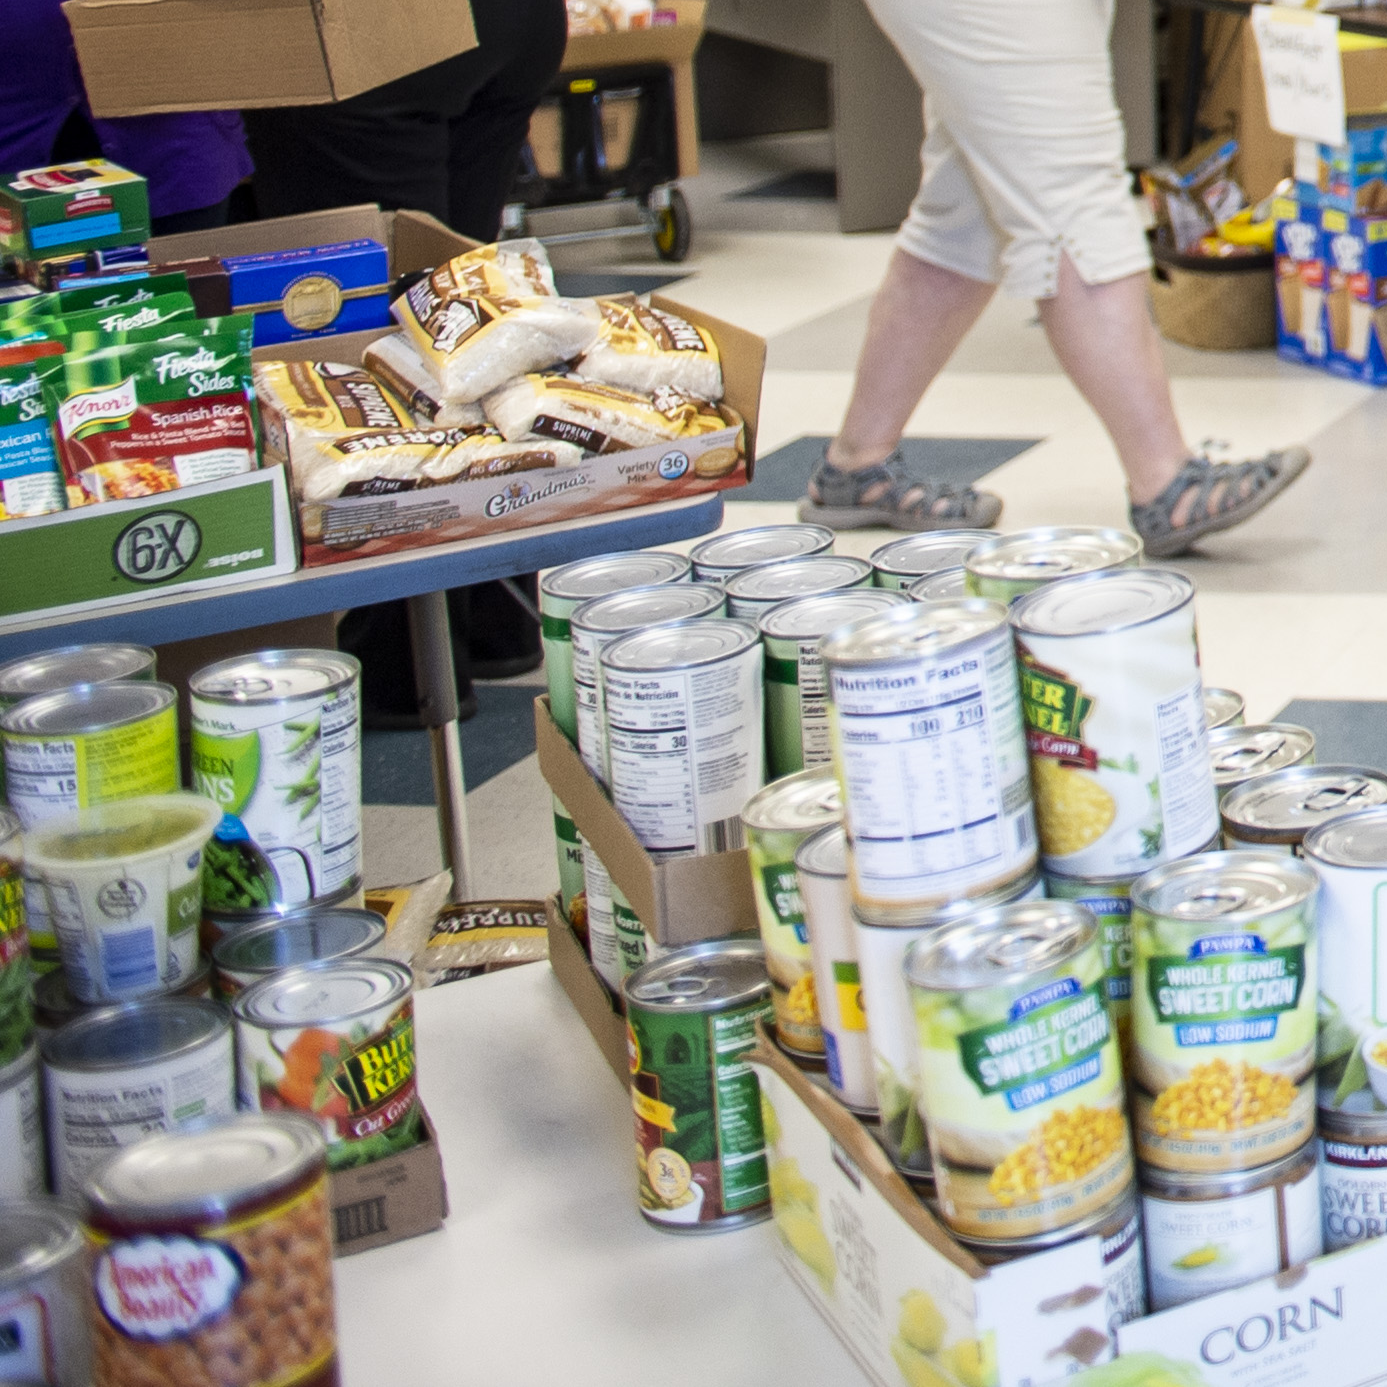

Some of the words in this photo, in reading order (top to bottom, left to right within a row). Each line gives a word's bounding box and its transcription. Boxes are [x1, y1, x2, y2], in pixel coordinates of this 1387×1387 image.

[97, 306, 162, 333] Fiesta
[153, 346, 217, 385] Fiesta
[188, 373, 236, 397] Sides
[64, 394, 132, 426] Knorr
[151, 408, 211, 429] Spanish
[211, 404, 243, 417] Rice
[552, 420, 593, 442] SUPREME
[617, 460, 658, 475] Variety
[662, 456, 684, 471] 36
[627, 473, 647, 485] Mix
[485, 473, 588, 519] Grandma's
[835, 674, 916, 692] Nutrition
[925, 659, 979, 683] Facts
[956, 704, 984, 727] 210
[671, 735, 687, 749] 30
[200, 754, 235, 777] EEN
[57, 779, 77, 793] 15
[1166, 963, 1222, 987] WHOLE
[1225, 956, 1287, 983] KERNEL
[1159, 982, 1235, 1015] SWEET
[1236, 975, 1299, 1011] CORN
[984, 1019, 1050, 1056] WHOLE
[1050, 994, 1101, 1032] KERNEL
[1180, 1025, 1212, 1046] LOW
[1214, 1018, 1275, 1042] SODIUM
[977, 1030, 1063, 1088] SWEET
[1062, 1009, 1111, 1057] CORN
[364, 1052, 415, 1101] KER
[1009, 1081, 1047, 1111] LOW
[1048, 1056, 1101, 1096] SODIUM
[1206, 1216, 1255, 1235] CORN
[1200, 1285, 1345, 1367] CORN
